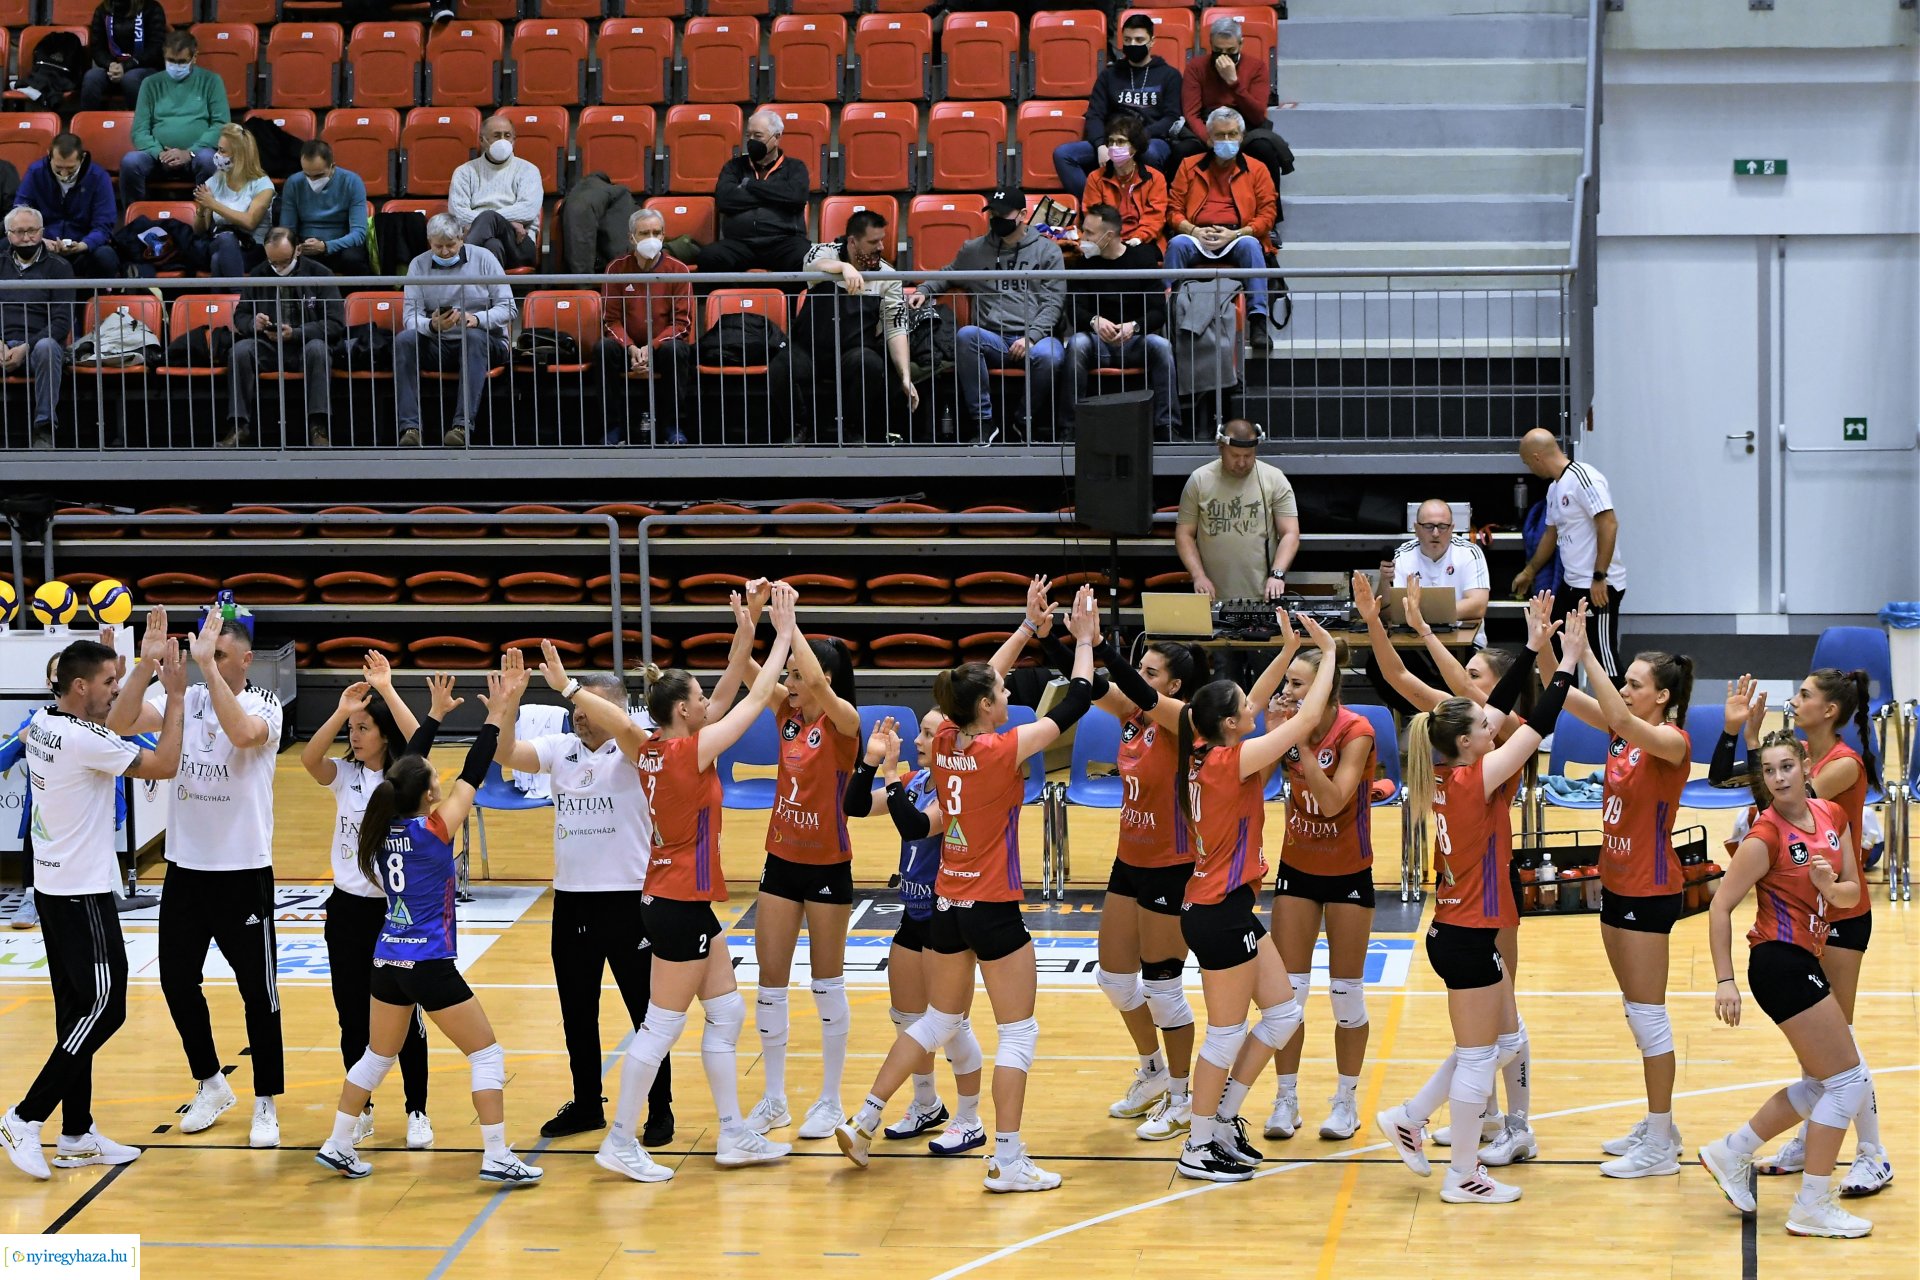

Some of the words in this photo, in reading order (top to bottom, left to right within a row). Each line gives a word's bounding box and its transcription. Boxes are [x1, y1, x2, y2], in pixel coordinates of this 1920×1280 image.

[1117, 97, 1158, 106] JONES
[1118, 91, 1149, 99] JACK
[181, 753, 230, 778] FATUM
[936, 752, 978, 771] MILANOVA
[647, 775, 656, 816] 2
[790, 776, 800, 802] 1
[946, 775, 962, 816] 3
[557, 793, 615, 812] FATUM
[1302, 790, 1319, 815] 11
[1603, 795, 1623, 825] 19
[568, 826, 616, 836] NYÍREGYHÁZA
[906, 846, 918, 872] 1
[387, 852, 406, 893] 8
[380, 933, 428, 944] TIESTRONG
[699, 934, 707, 953] 2
[1243, 930, 1257, 953] 10
[1518, 1061, 1528, 1088] MIKASA
